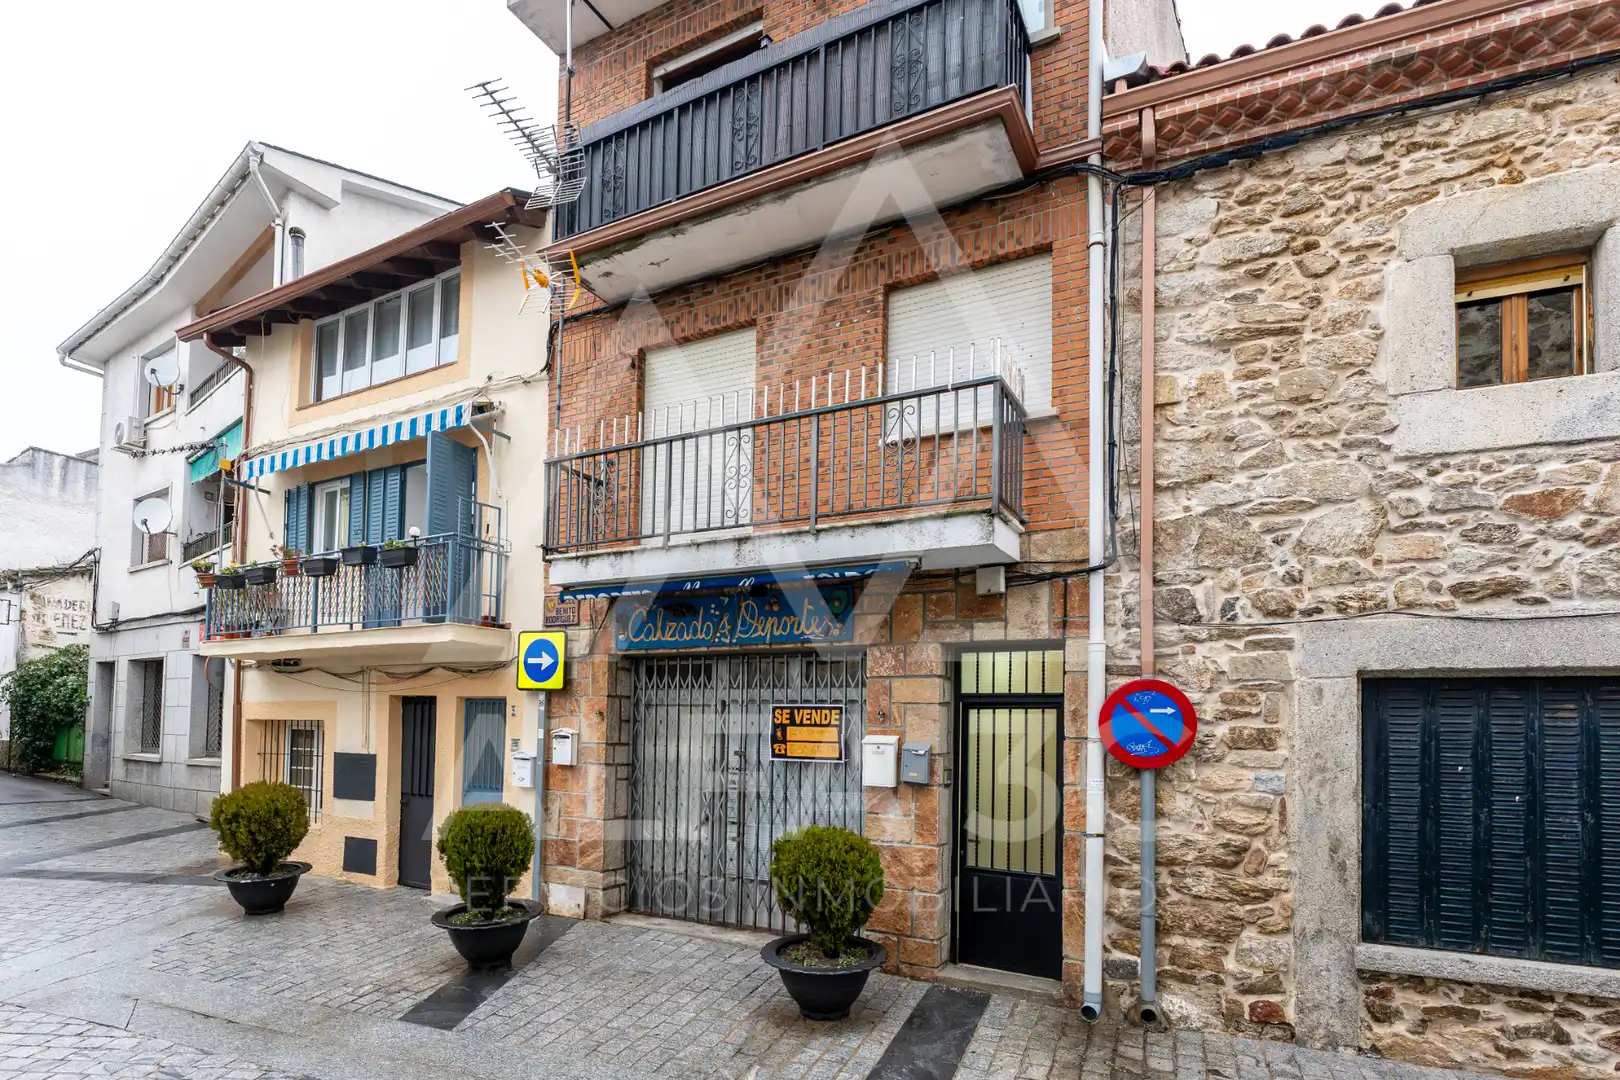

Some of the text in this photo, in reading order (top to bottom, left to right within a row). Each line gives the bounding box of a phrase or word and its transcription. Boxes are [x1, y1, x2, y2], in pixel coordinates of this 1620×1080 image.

[555, 606, 576, 616] BENITO
[735, 597, 835, 643] Deportes
[773, 708, 841, 725] SE VENDE
